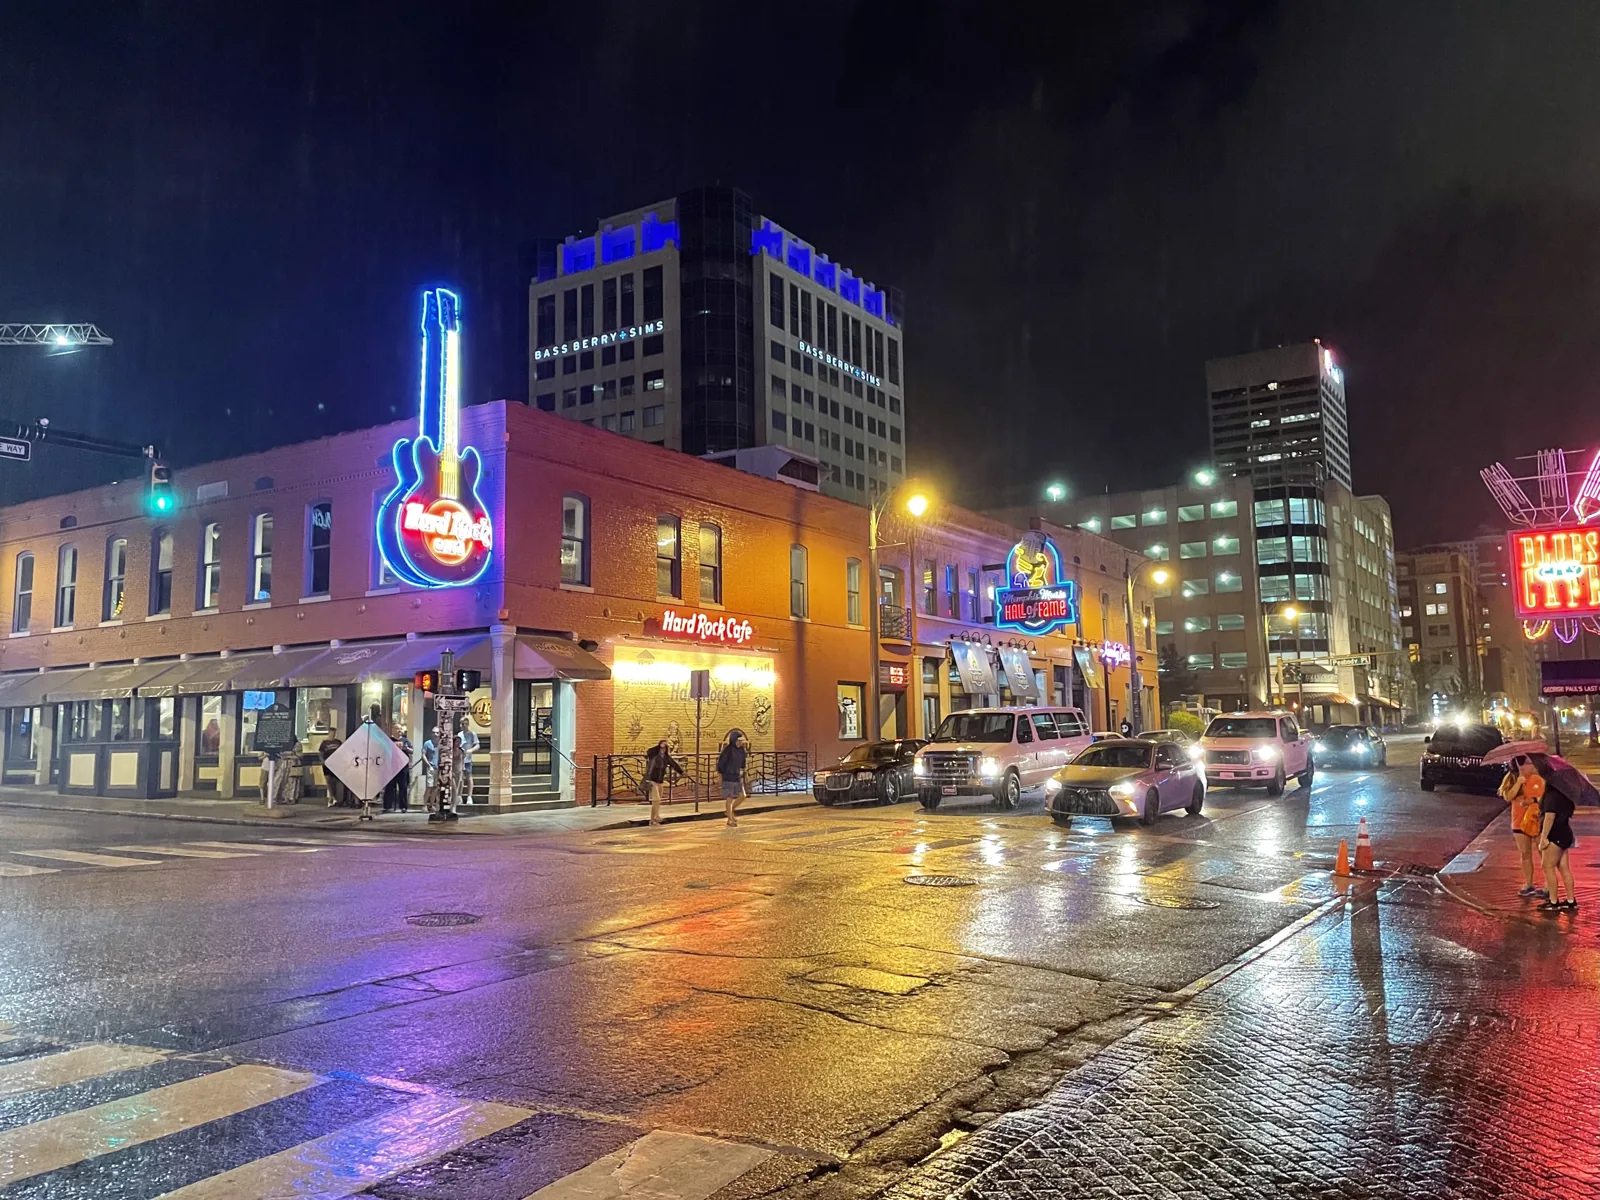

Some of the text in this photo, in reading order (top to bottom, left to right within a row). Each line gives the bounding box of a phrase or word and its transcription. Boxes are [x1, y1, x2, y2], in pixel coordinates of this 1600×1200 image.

[534, 343, 569, 361] BASS
[573, 331, 618, 353] BERRY
[629, 319, 666, 338] SIMS
[799, 340, 825, 361] BASS
[826, 352, 855, 375] BERRY
[860, 370, 882, 388] SIMS
[6, 444, 24, 454] WAY
[1518, 530, 1598, 569] BLUES
[1004, 603, 1027, 621] HALL
[663, 610, 753, 644] Hard Rock Cafe
[1332, 658, 1359, 667] Peabody
[1542, 685, 1565, 694] GEORGE
[1564, 685, 1584, 693] PAUL'S
[1583, 685, 1598, 693] LAST
